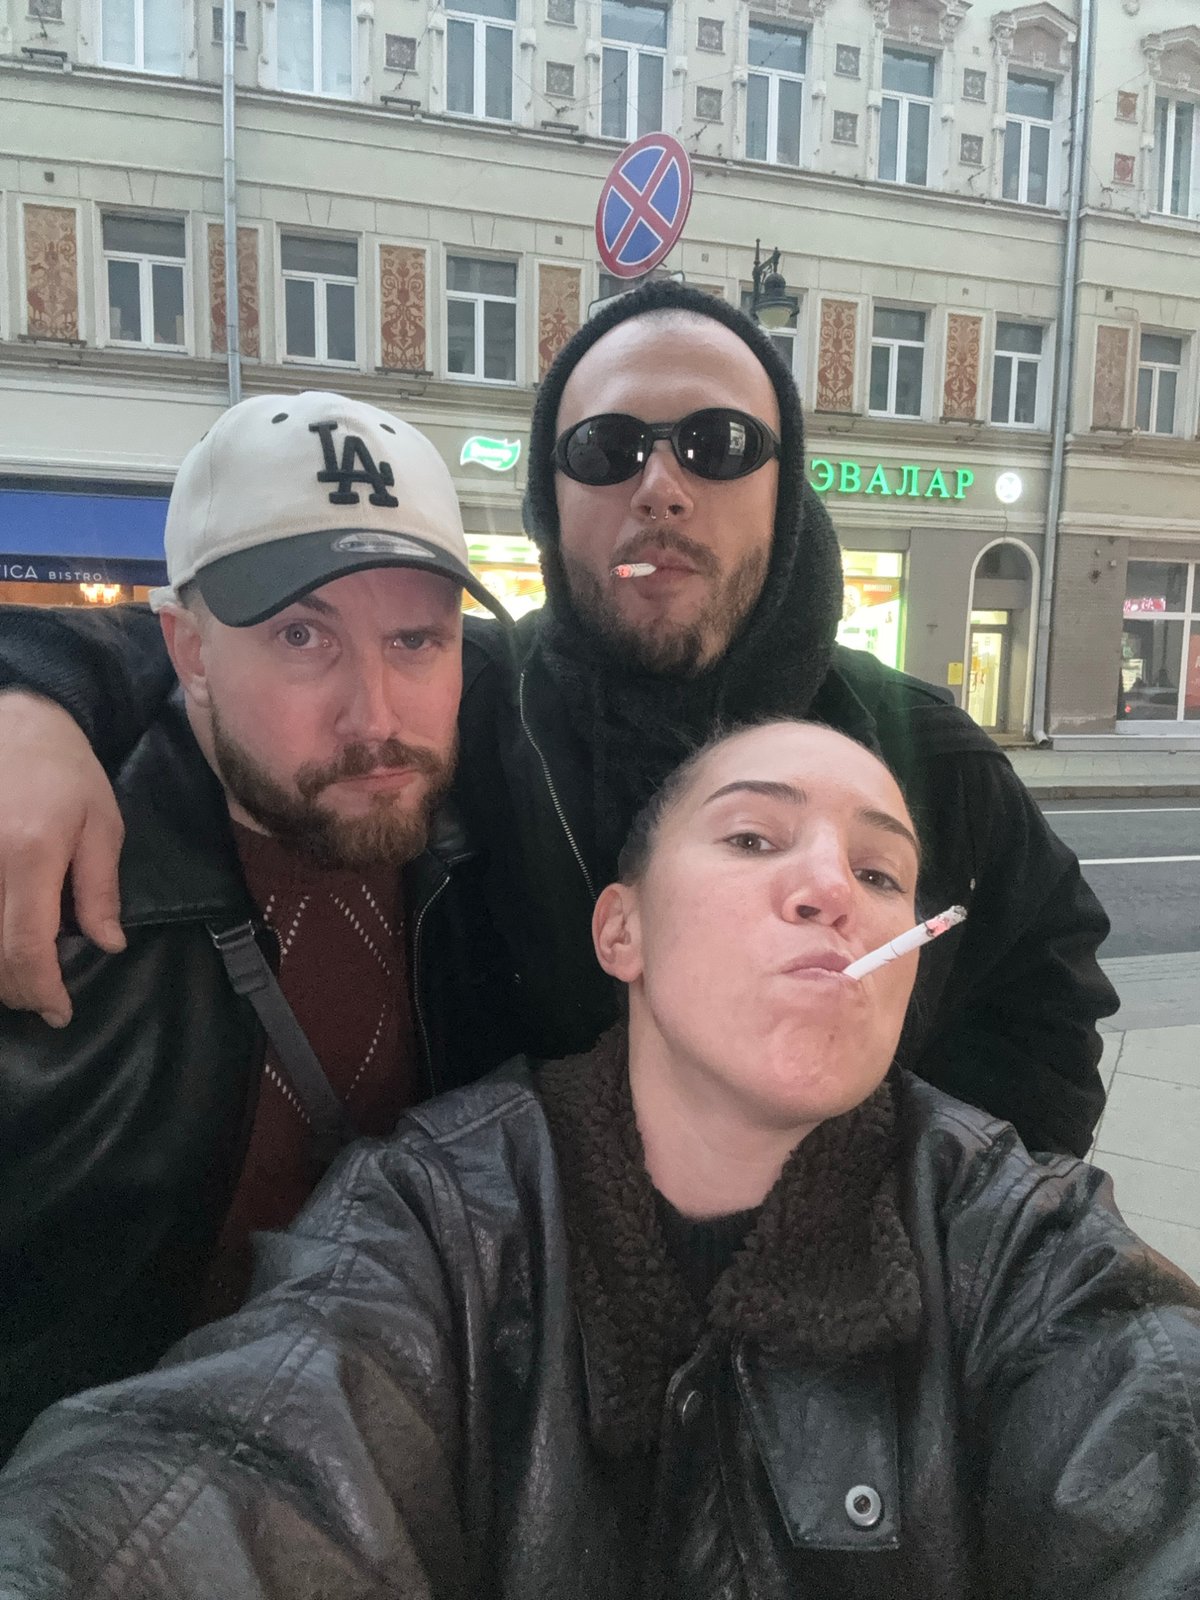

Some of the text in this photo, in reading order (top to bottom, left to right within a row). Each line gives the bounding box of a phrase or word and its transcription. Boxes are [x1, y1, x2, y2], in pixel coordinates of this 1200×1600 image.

[308, 421, 399, 508] LA
[810, 459, 975, 499] ЭВАЛАР
[0, 564, 102, 581] ICA BISTRO
